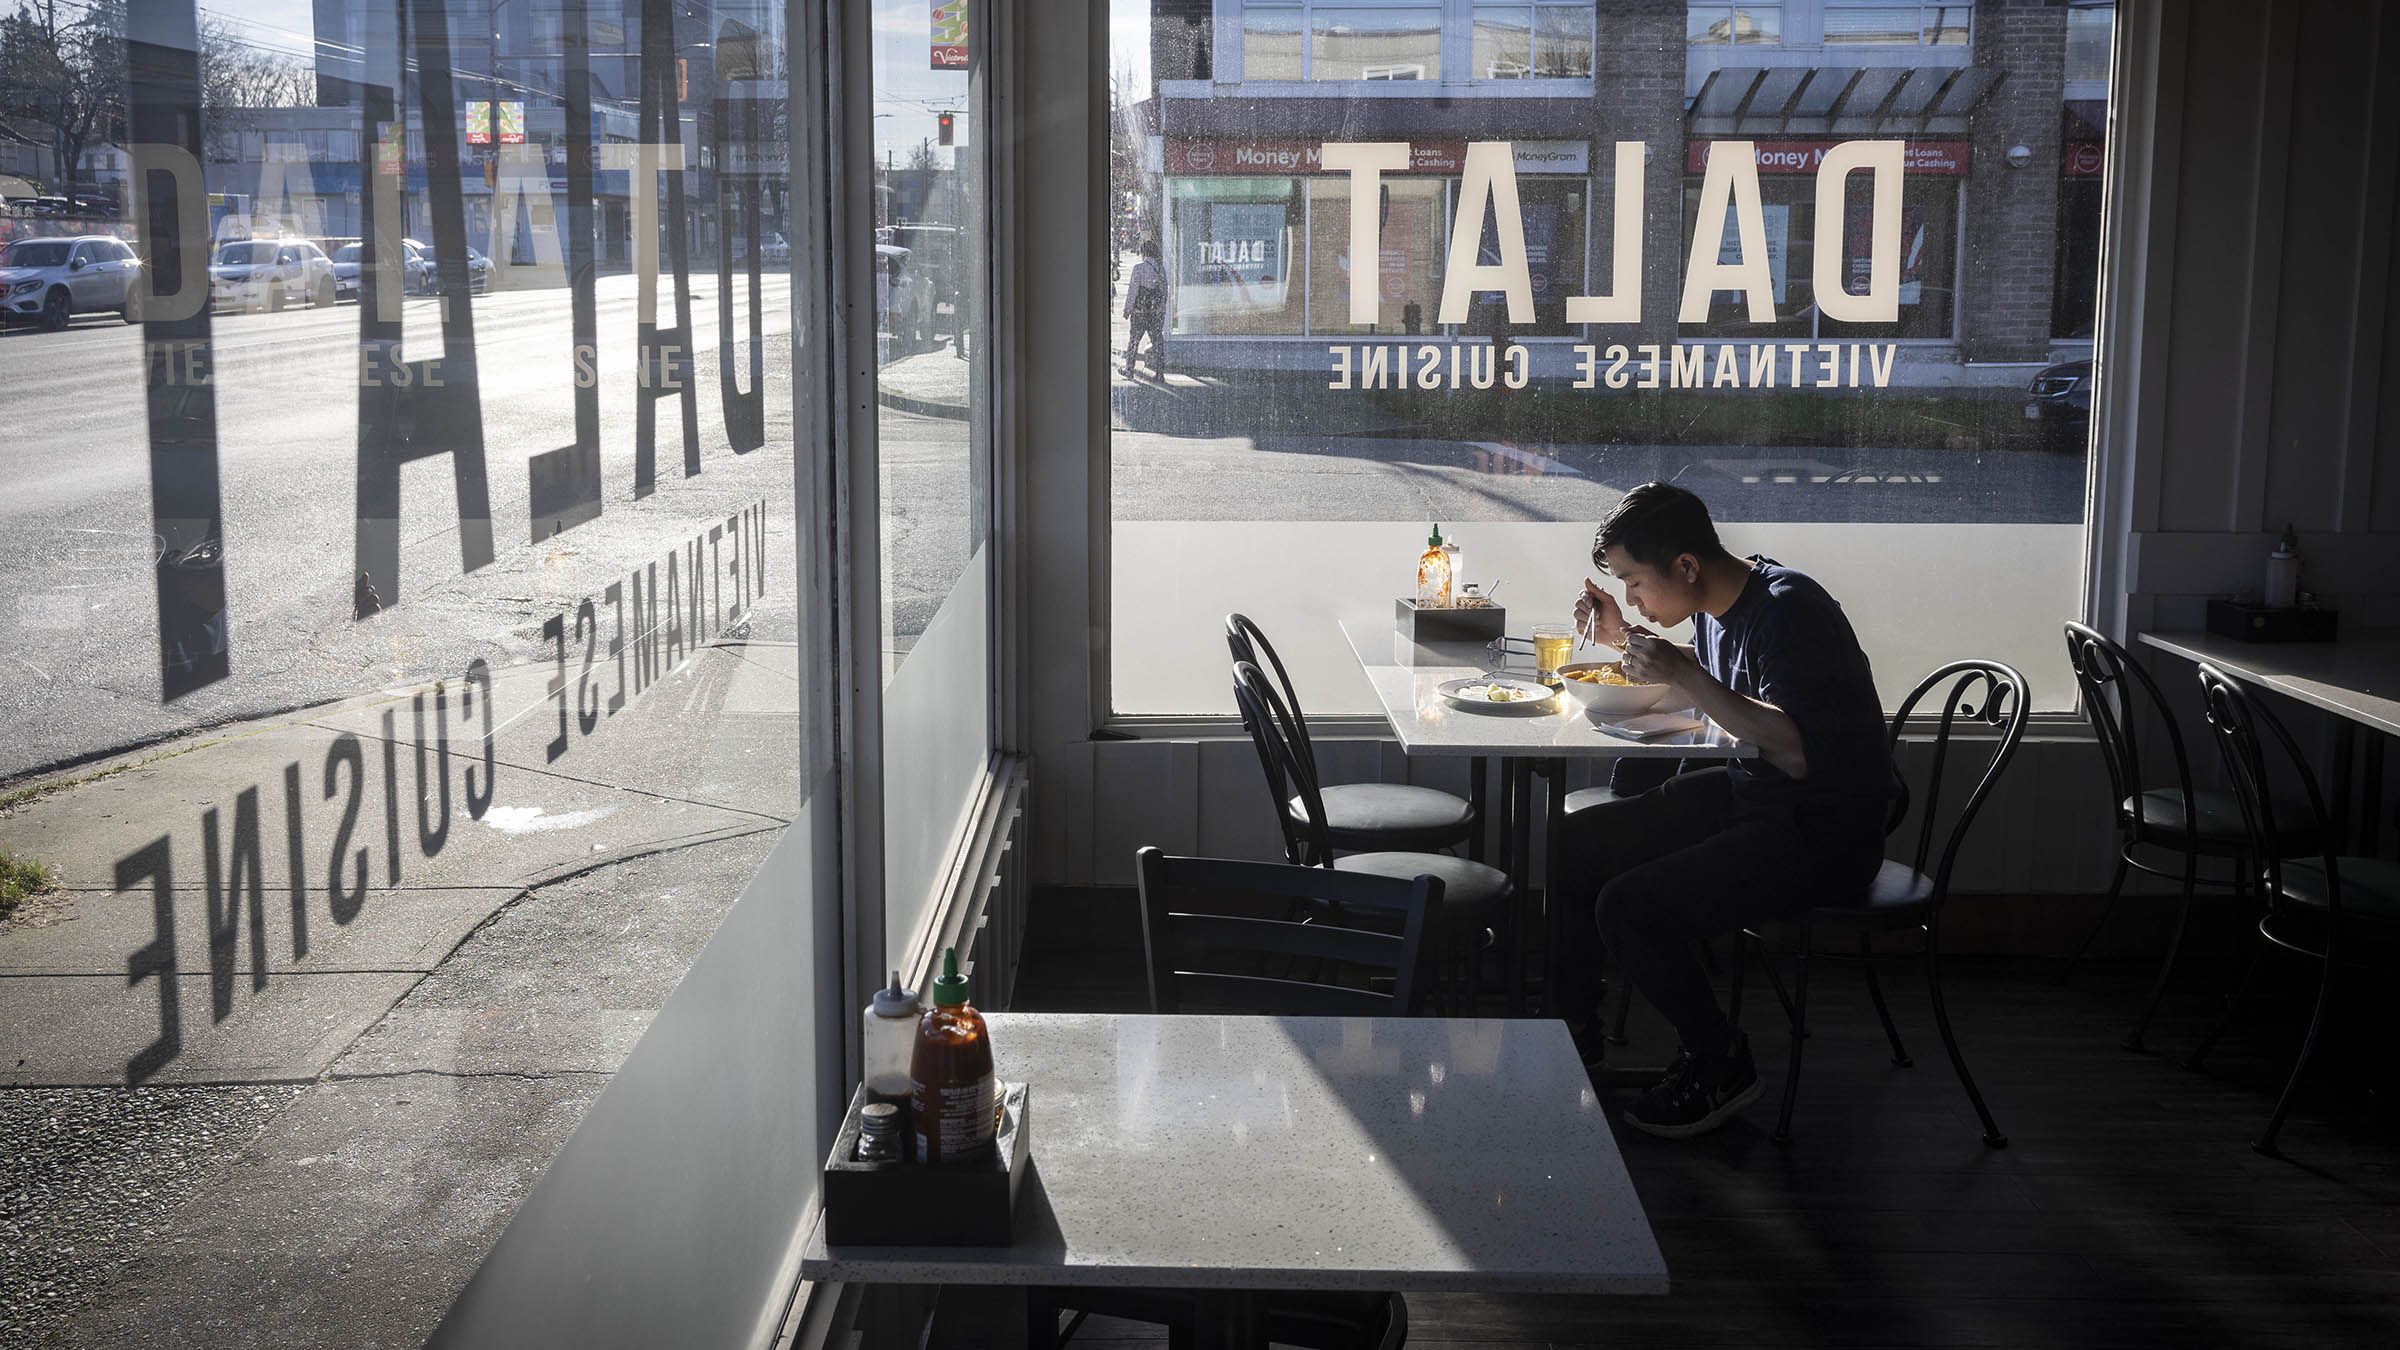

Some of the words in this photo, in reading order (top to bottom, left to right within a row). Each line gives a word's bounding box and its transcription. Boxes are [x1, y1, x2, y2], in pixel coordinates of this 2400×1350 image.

[1236, 147, 1300, 168] Money
[1415, 148, 1442, 157] Loans
[1517, 151, 1577, 163] MoneyGram
[1915, 149, 1943, 157] Loans
[1416, 158, 1455, 169] Cashing
[1917, 159, 1956, 169] Cashing
